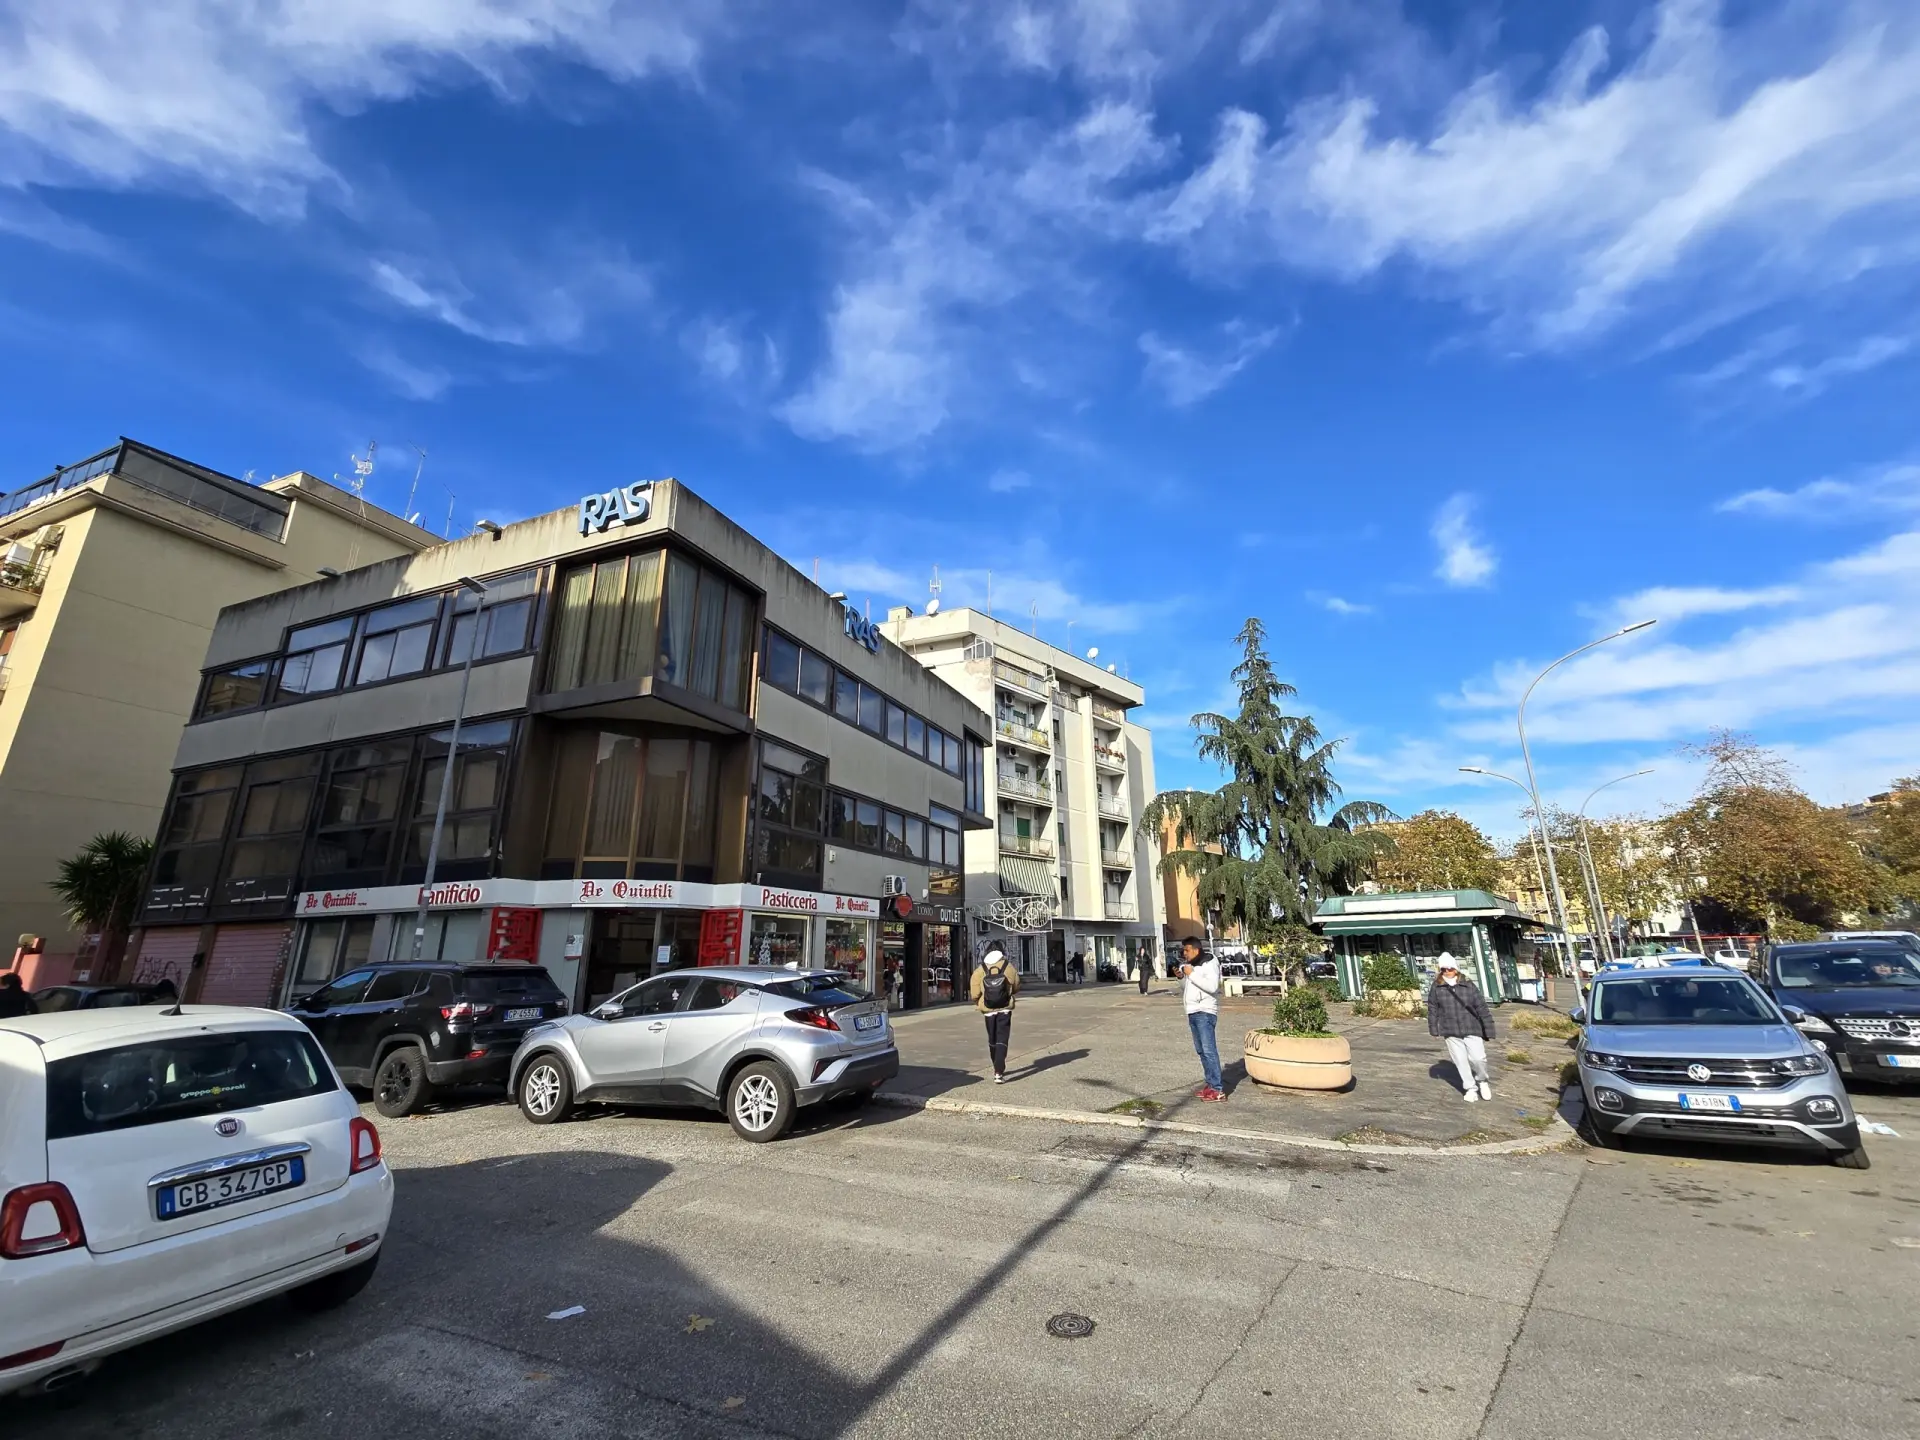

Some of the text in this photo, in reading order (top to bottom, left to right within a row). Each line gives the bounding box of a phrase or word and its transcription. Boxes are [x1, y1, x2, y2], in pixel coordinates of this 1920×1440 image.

[579, 479, 650, 537] RAS
[846, 606, 881, 653] RAS
[322, 892, 357, 909] Quintili
[578, 881, 673, 902] De Quintili
[762, 889, 818, 910] Pasticceria
[940, 908, 961, 923] OUTLET
